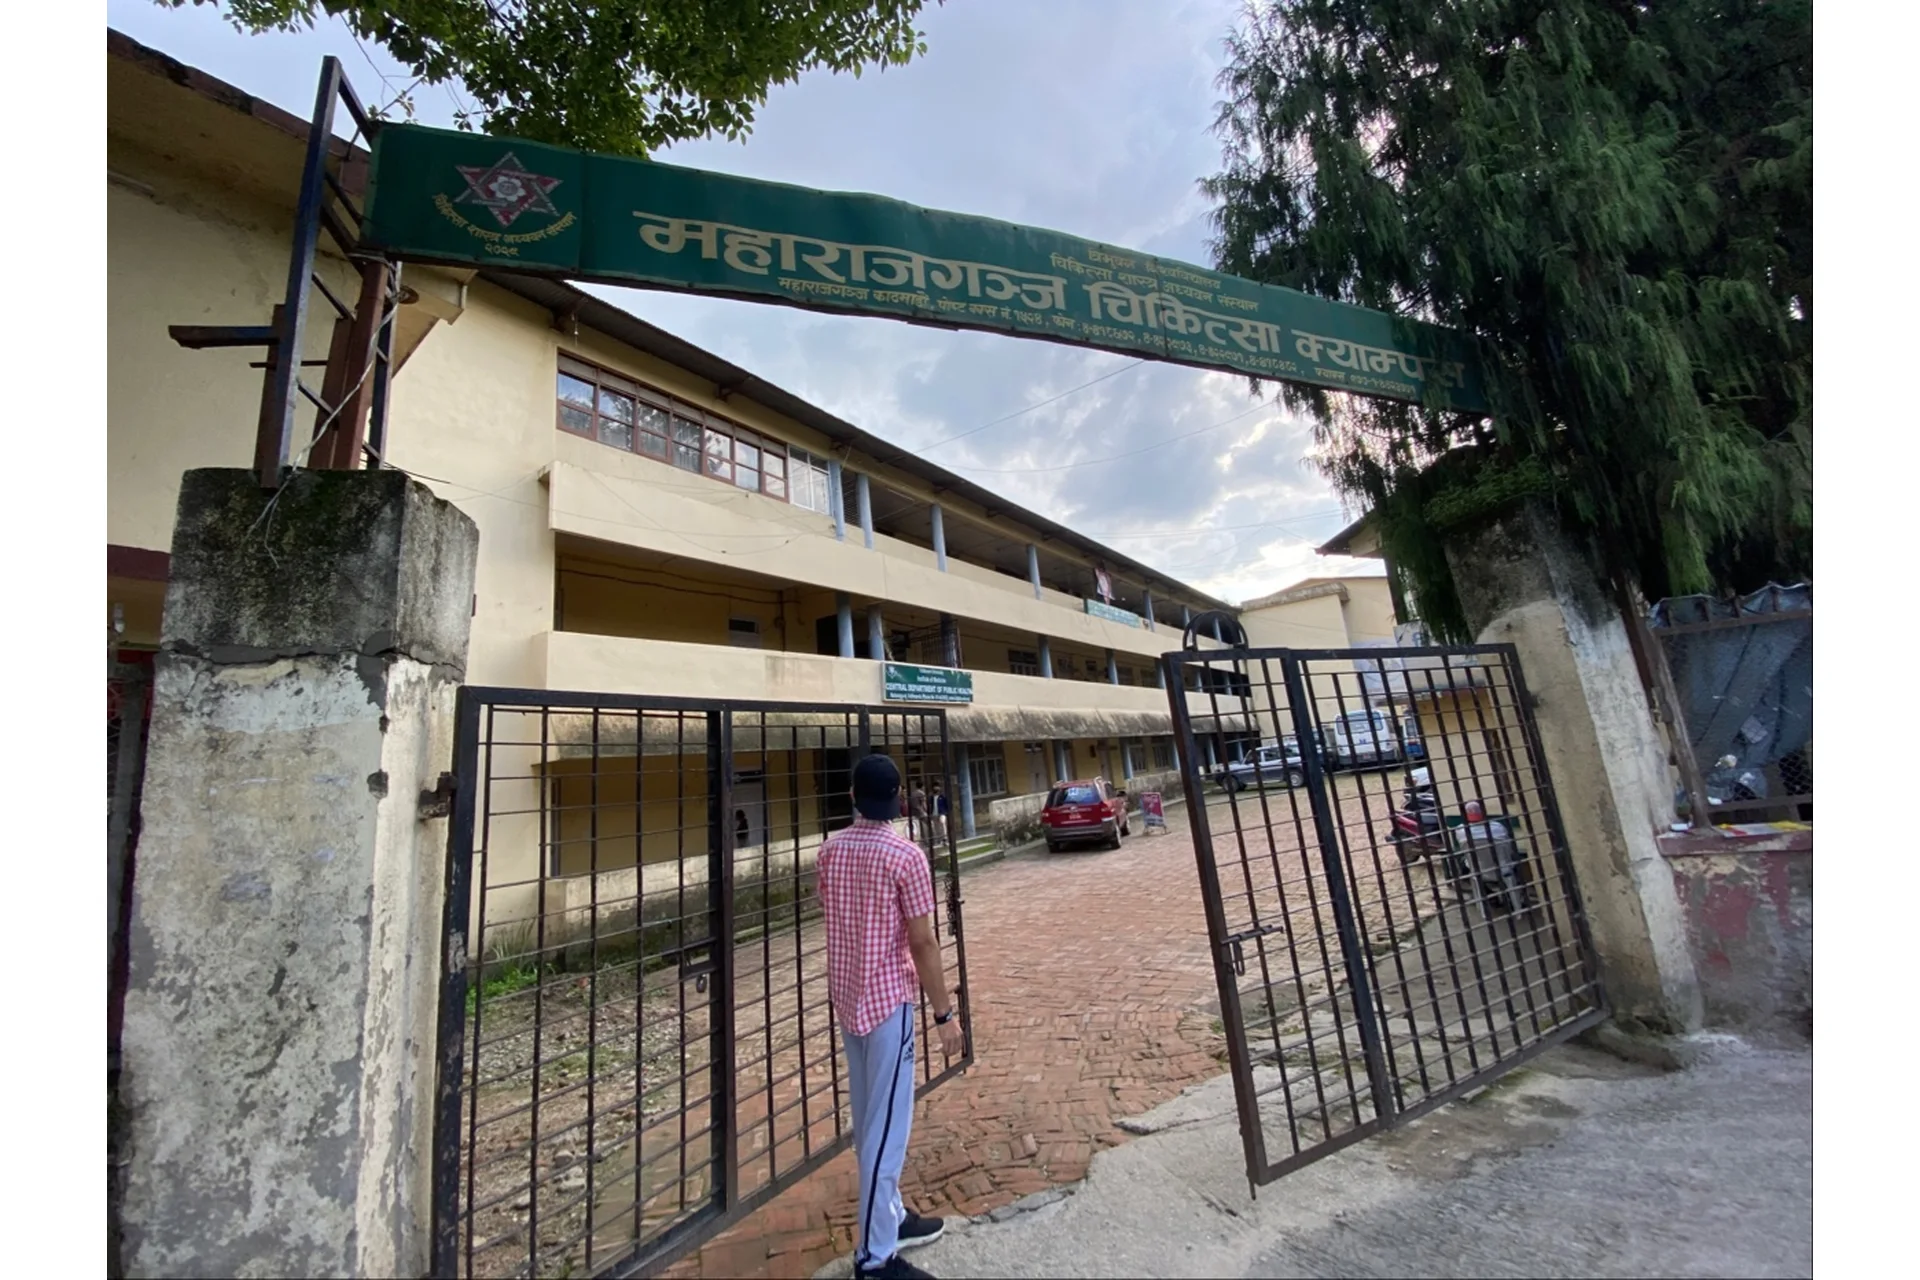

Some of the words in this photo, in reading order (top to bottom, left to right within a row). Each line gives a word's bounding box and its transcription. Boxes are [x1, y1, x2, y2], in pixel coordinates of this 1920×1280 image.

[632, 209, 1068, 311] महाराजगञ्ज
[1083, 279, 1282, 353] चिकित्सा
[777, 276, 870, 302] महाराजगञ्ज
[1049, 251, 1113, 281] चिकित्सा
[1163, 280, 1214, 304] अध्ययन
[886, 683, 907, 691] CENTRAL
[908, 683, 936, 693] DEPARTMENT
[937, 685, 943, 693] OF
[943, 686, 957, 694] PUBLIC
